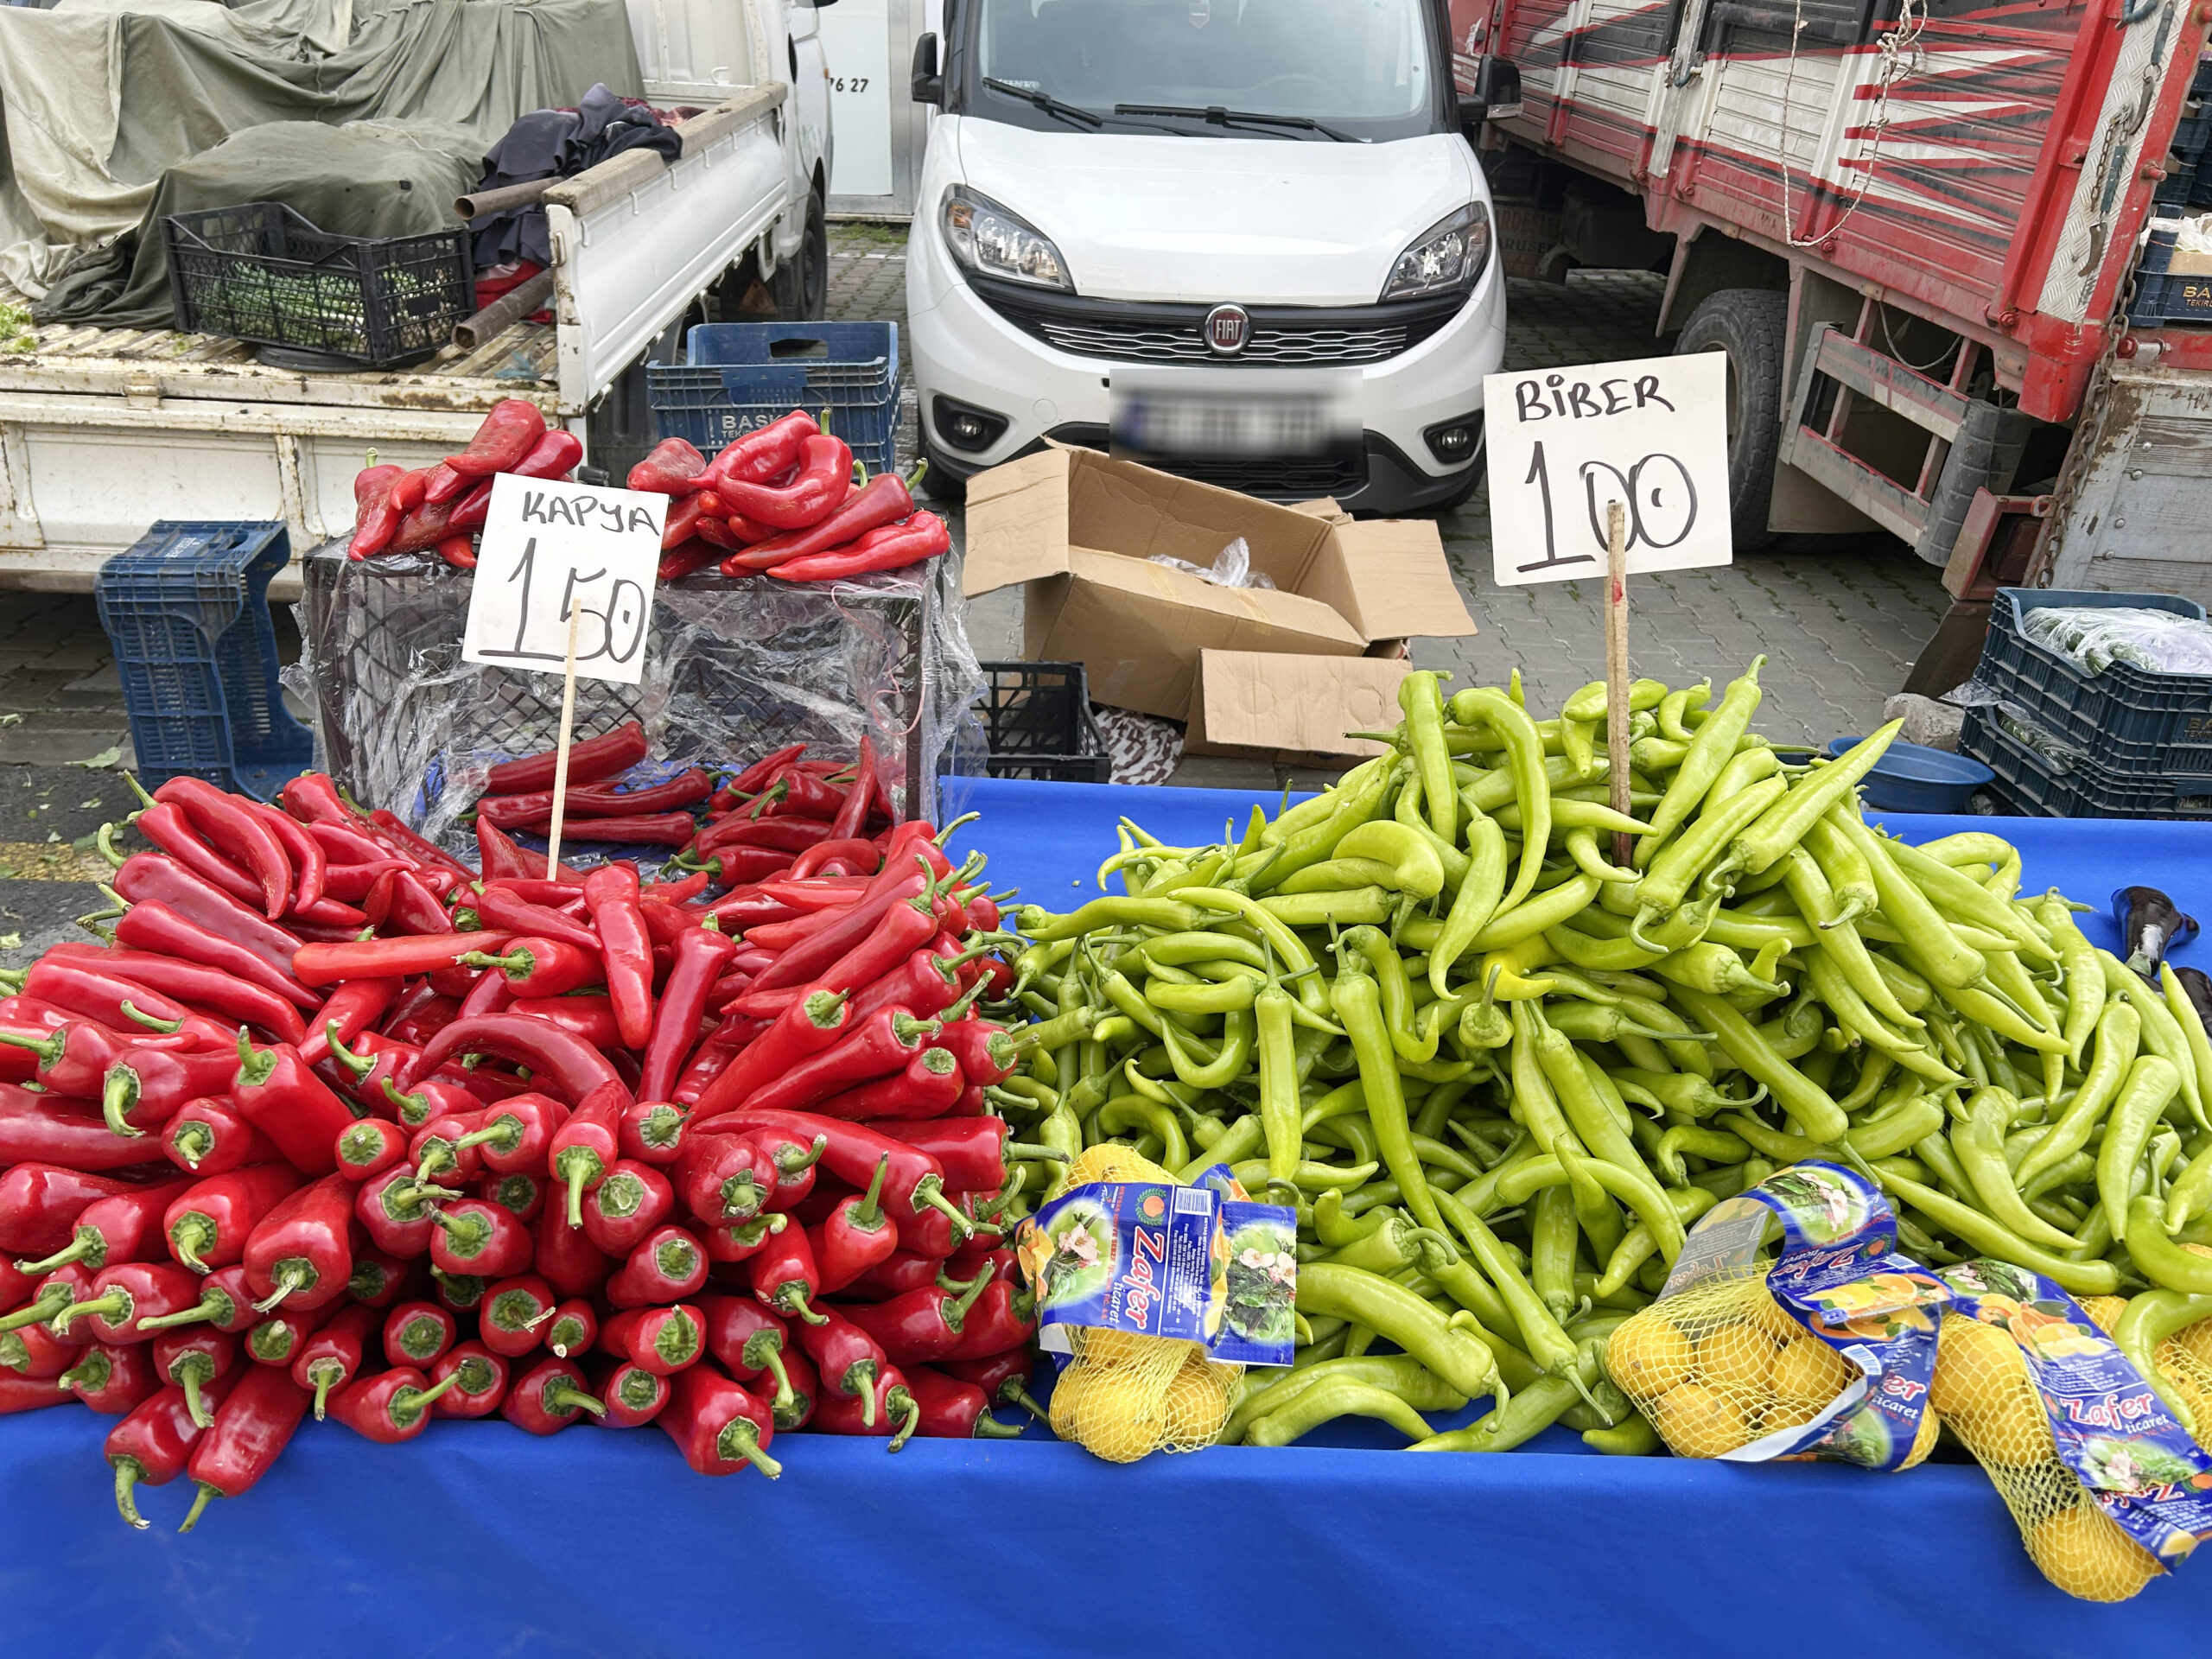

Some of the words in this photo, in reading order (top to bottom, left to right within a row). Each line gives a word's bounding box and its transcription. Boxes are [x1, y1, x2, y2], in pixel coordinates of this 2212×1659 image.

[850, 78, 869, 92] 27
[1215, 319, 1242, 340] FIAT
[522, 491, 660, 536] KAPYA
[1516, 441, 1698, 573] 100
[478, 537, 646, 663] 150
[1122, 1226, 1165, 1330] Zafer
[1109, 1282, 1126, 1324] ticaret
[2060, 1393, 2154, 1430] Zafer
[2125, 1414, 2169, 1434] ticaret
